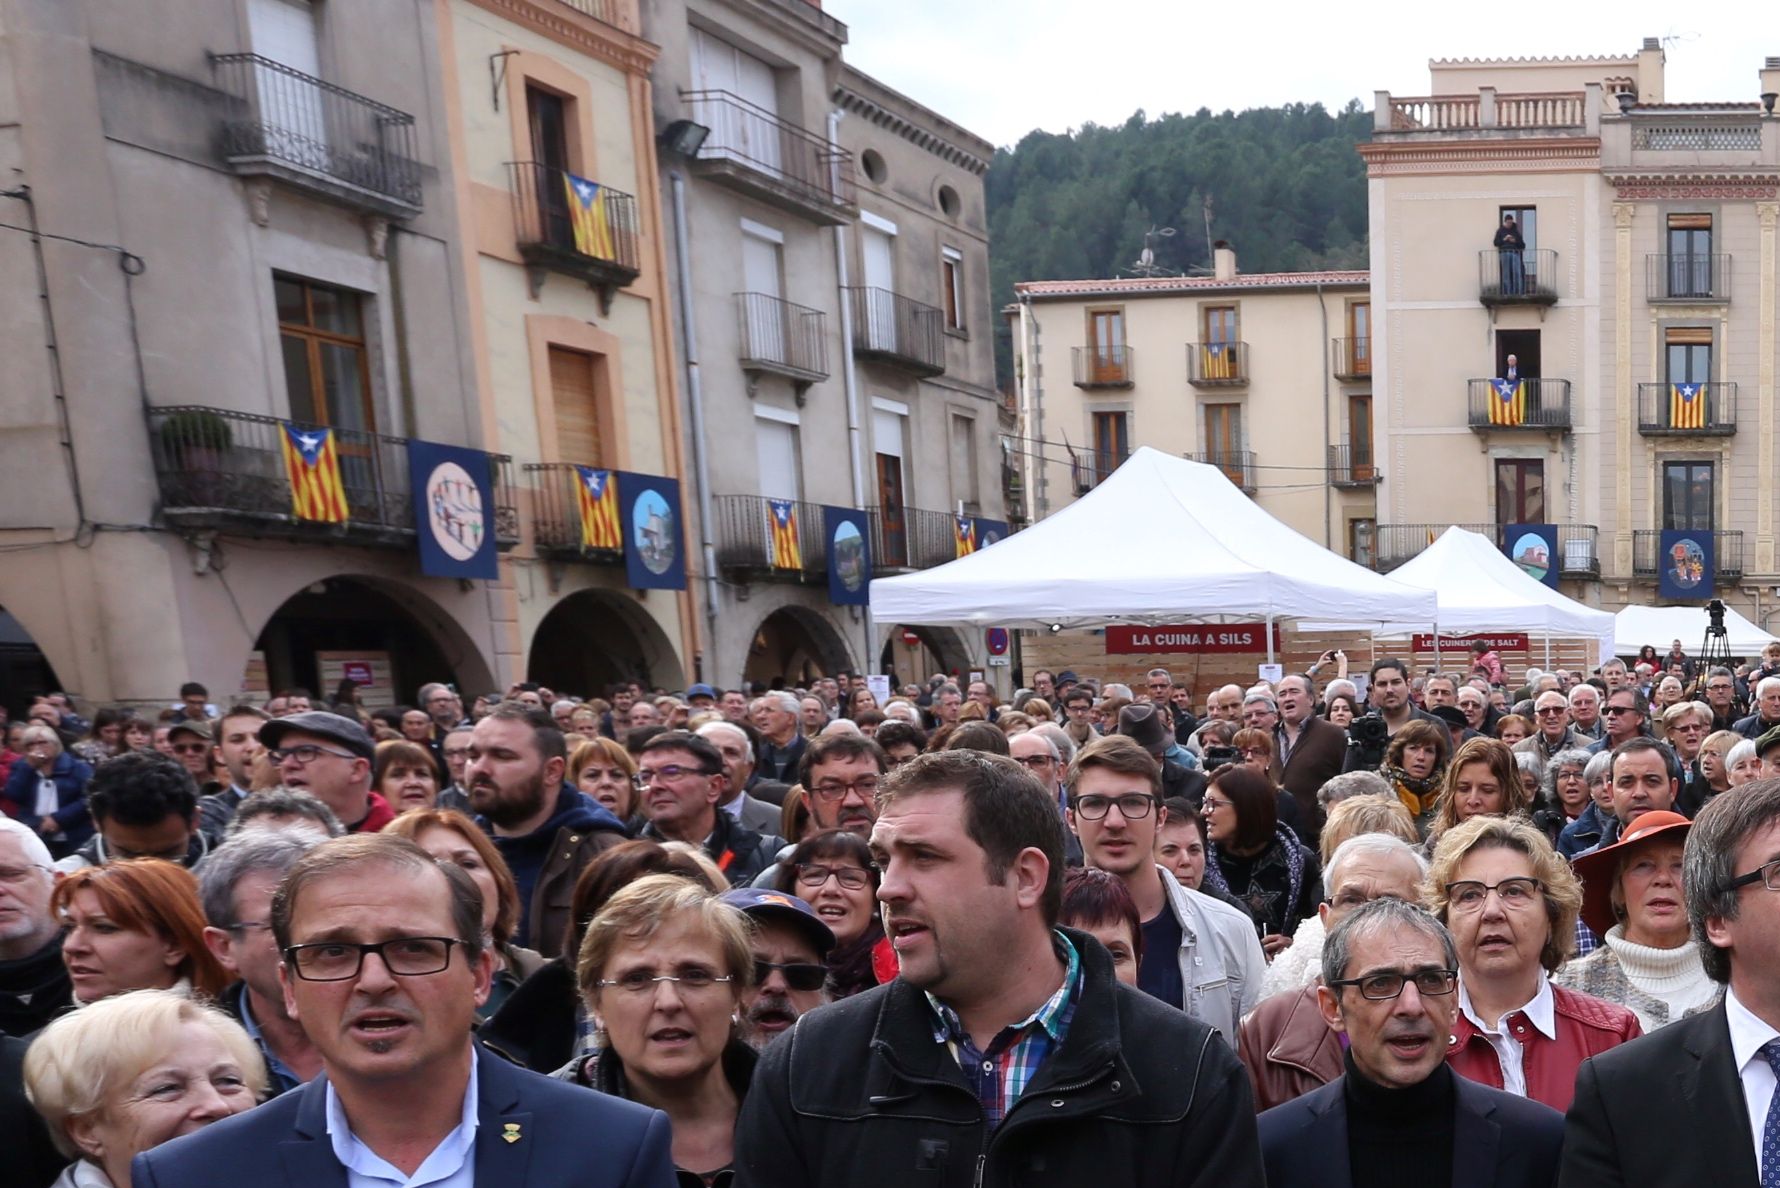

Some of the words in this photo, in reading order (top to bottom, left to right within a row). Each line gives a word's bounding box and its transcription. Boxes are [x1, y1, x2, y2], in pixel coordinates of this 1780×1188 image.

[1132, 634, 1151, 646] LA
[1154, 633, 1201, 646] CUINA
[1205, 633, 1215, 645] A
[1219, 633, 1252, 645] SILS
[1497, 639, 1519, 647] SALT
